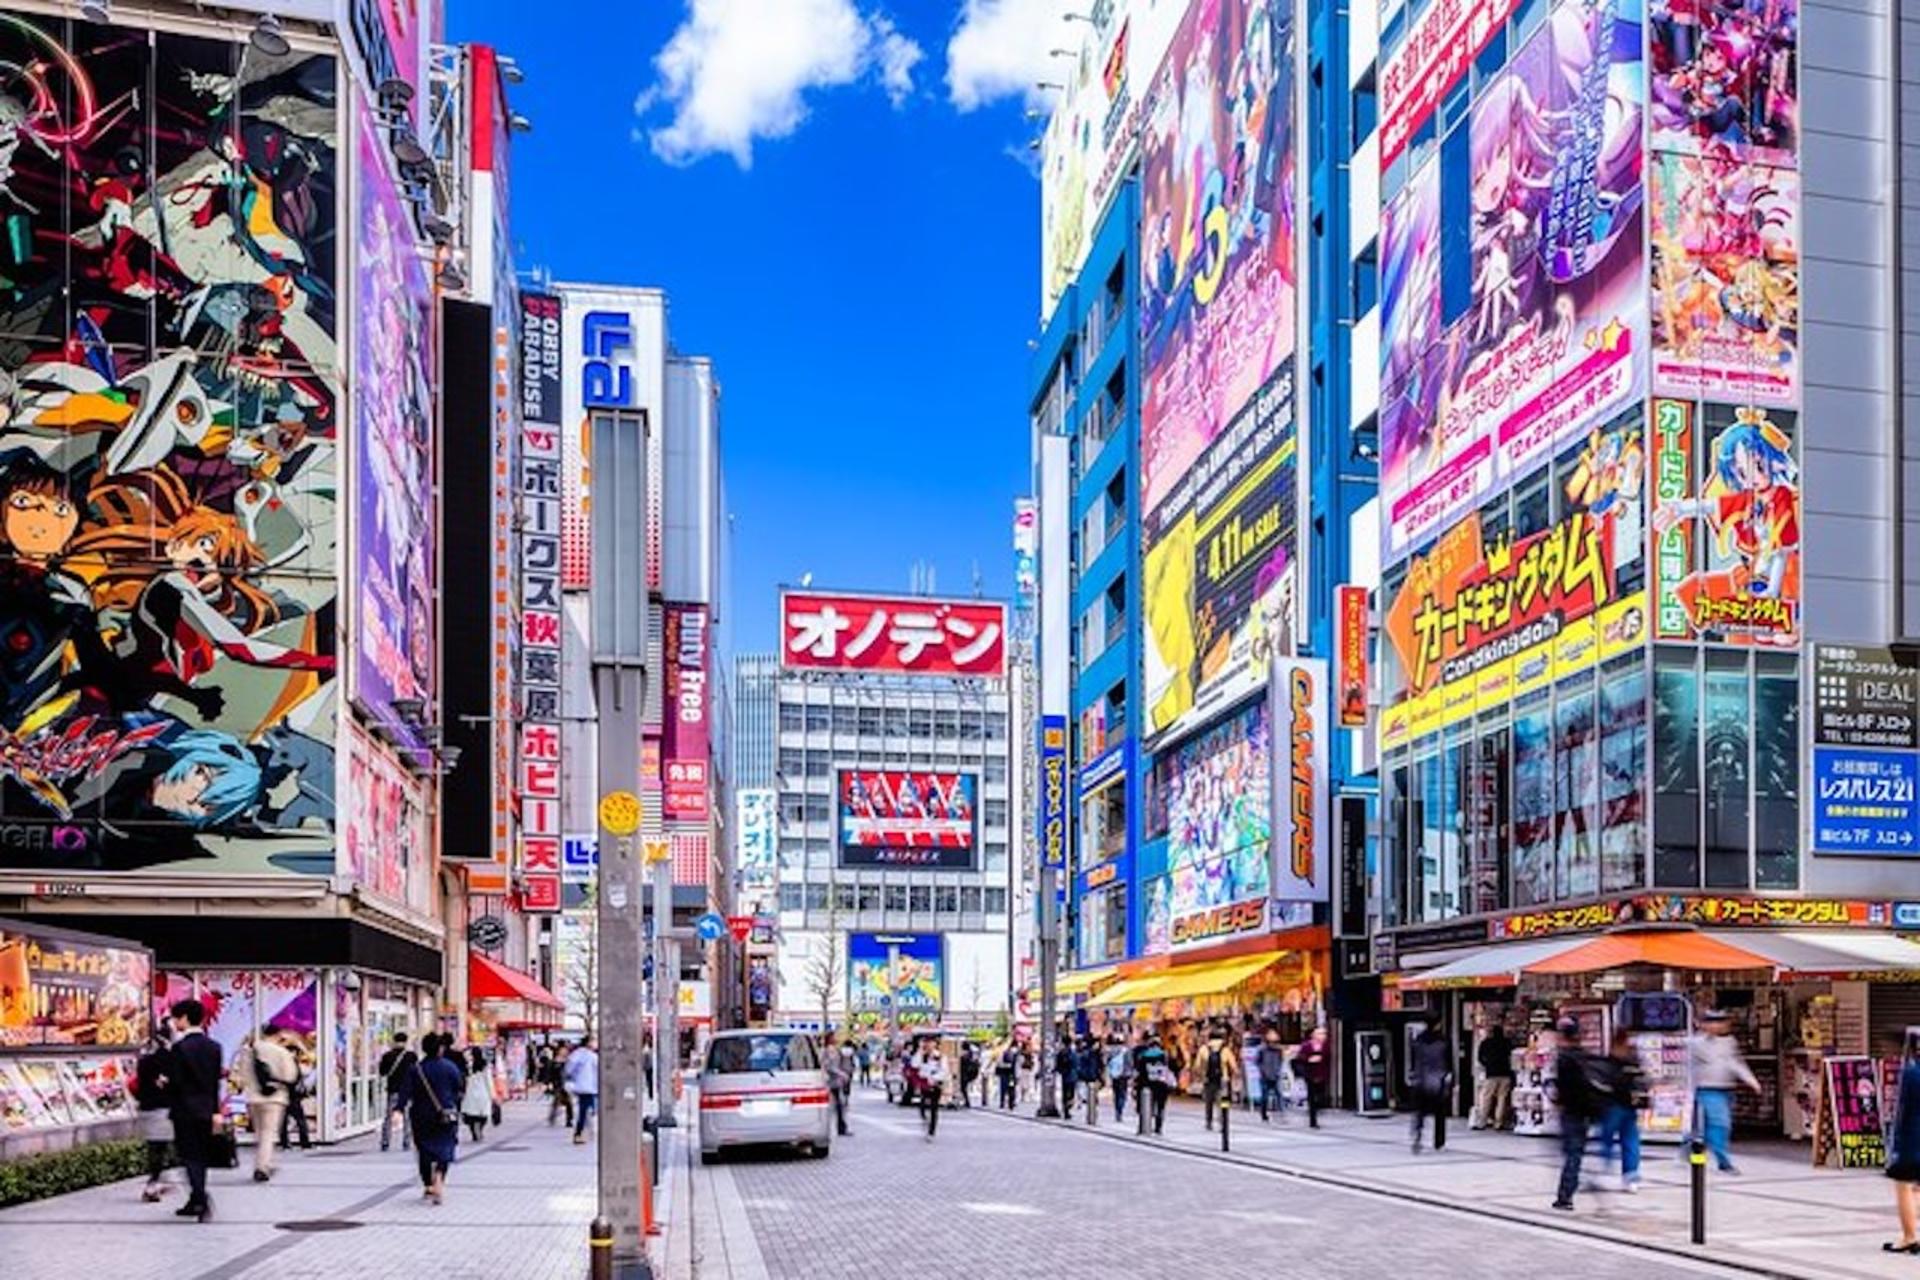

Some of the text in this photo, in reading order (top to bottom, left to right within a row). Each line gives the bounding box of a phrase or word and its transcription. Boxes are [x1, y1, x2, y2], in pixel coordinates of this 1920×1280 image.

[522, 296, 544, 417] PARADISE
[542, 296, 560, 381] HOBBY
[1412, 512, 1609, 688] カードキングダム
[789, 604, 1000, 667] オノデン
[681, 669, 706, 723] Free
[1290, 668, 1316, 888] GAMERS
[1820, 776, 1914, 802] レオパレス21
[1171, 896, 1267, 945] GAMERS
[1723, 899, 1849, 924] カードキングダム
